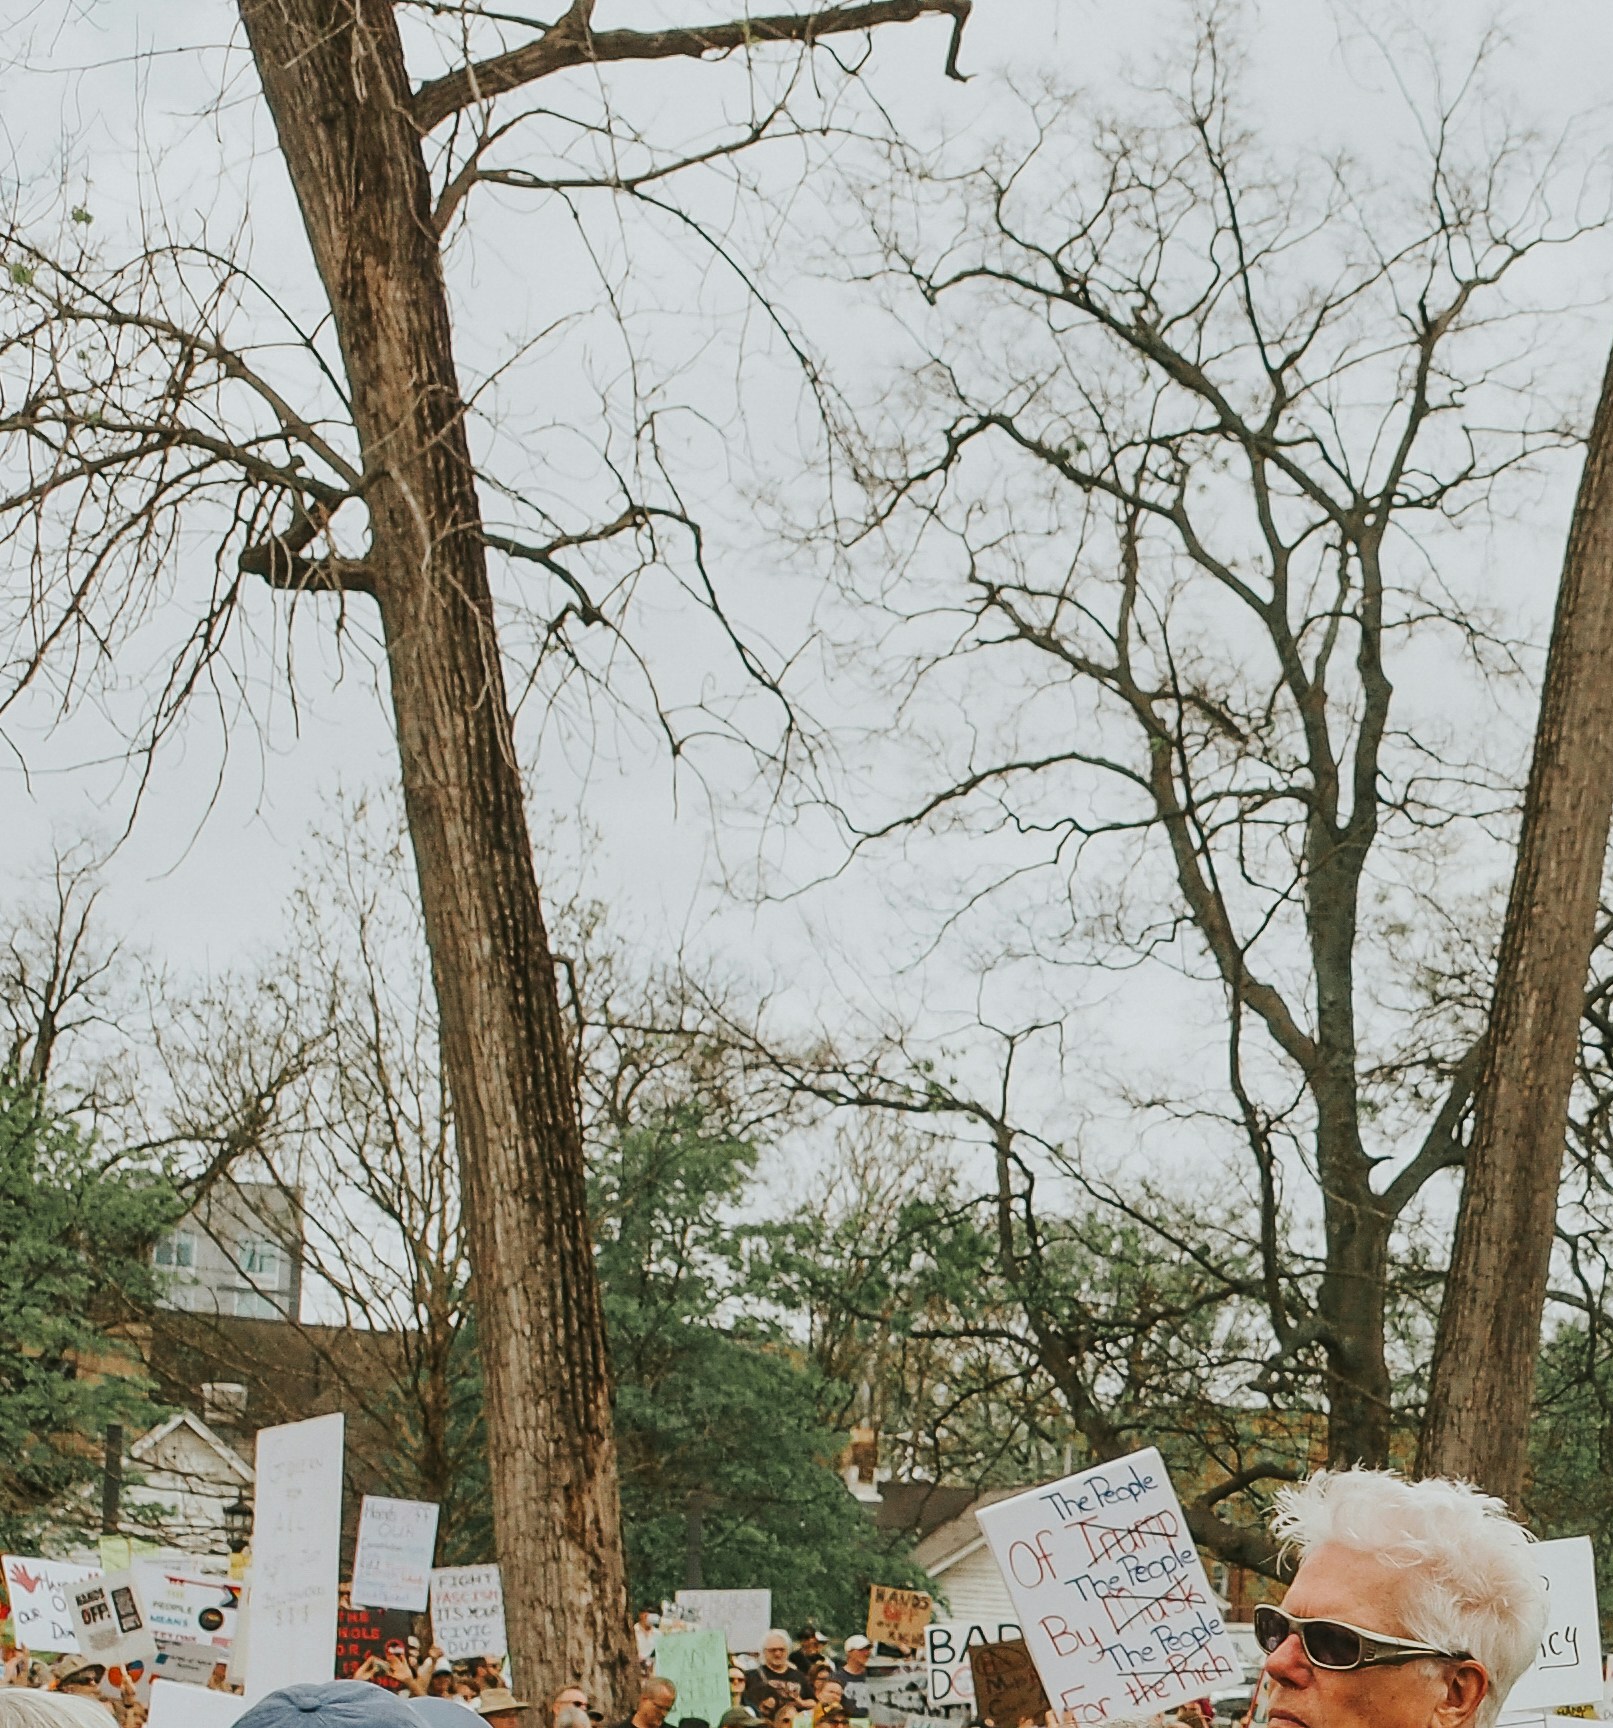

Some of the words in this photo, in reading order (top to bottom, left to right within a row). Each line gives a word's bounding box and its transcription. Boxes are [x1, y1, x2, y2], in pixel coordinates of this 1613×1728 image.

[1040, 1492, 1094, 1521] The
[1083, 1465, 1159, 1508] People
[439, 1574, 491, 1588] FIGHT
[1008, 1529, 1057, 1589] Of
[1063, 1573, 1121, 1602] The
[1116, 1547, 1197, 1585] People
[440, 1625, 492, 1641] CIVIC
[447, 1641, 491, 1655] DUTY
[1038, 1615, 1107, 1664] By
[1102, 1643, 1157, 1671] The
[1150, 1611, 1225, 1655] People
